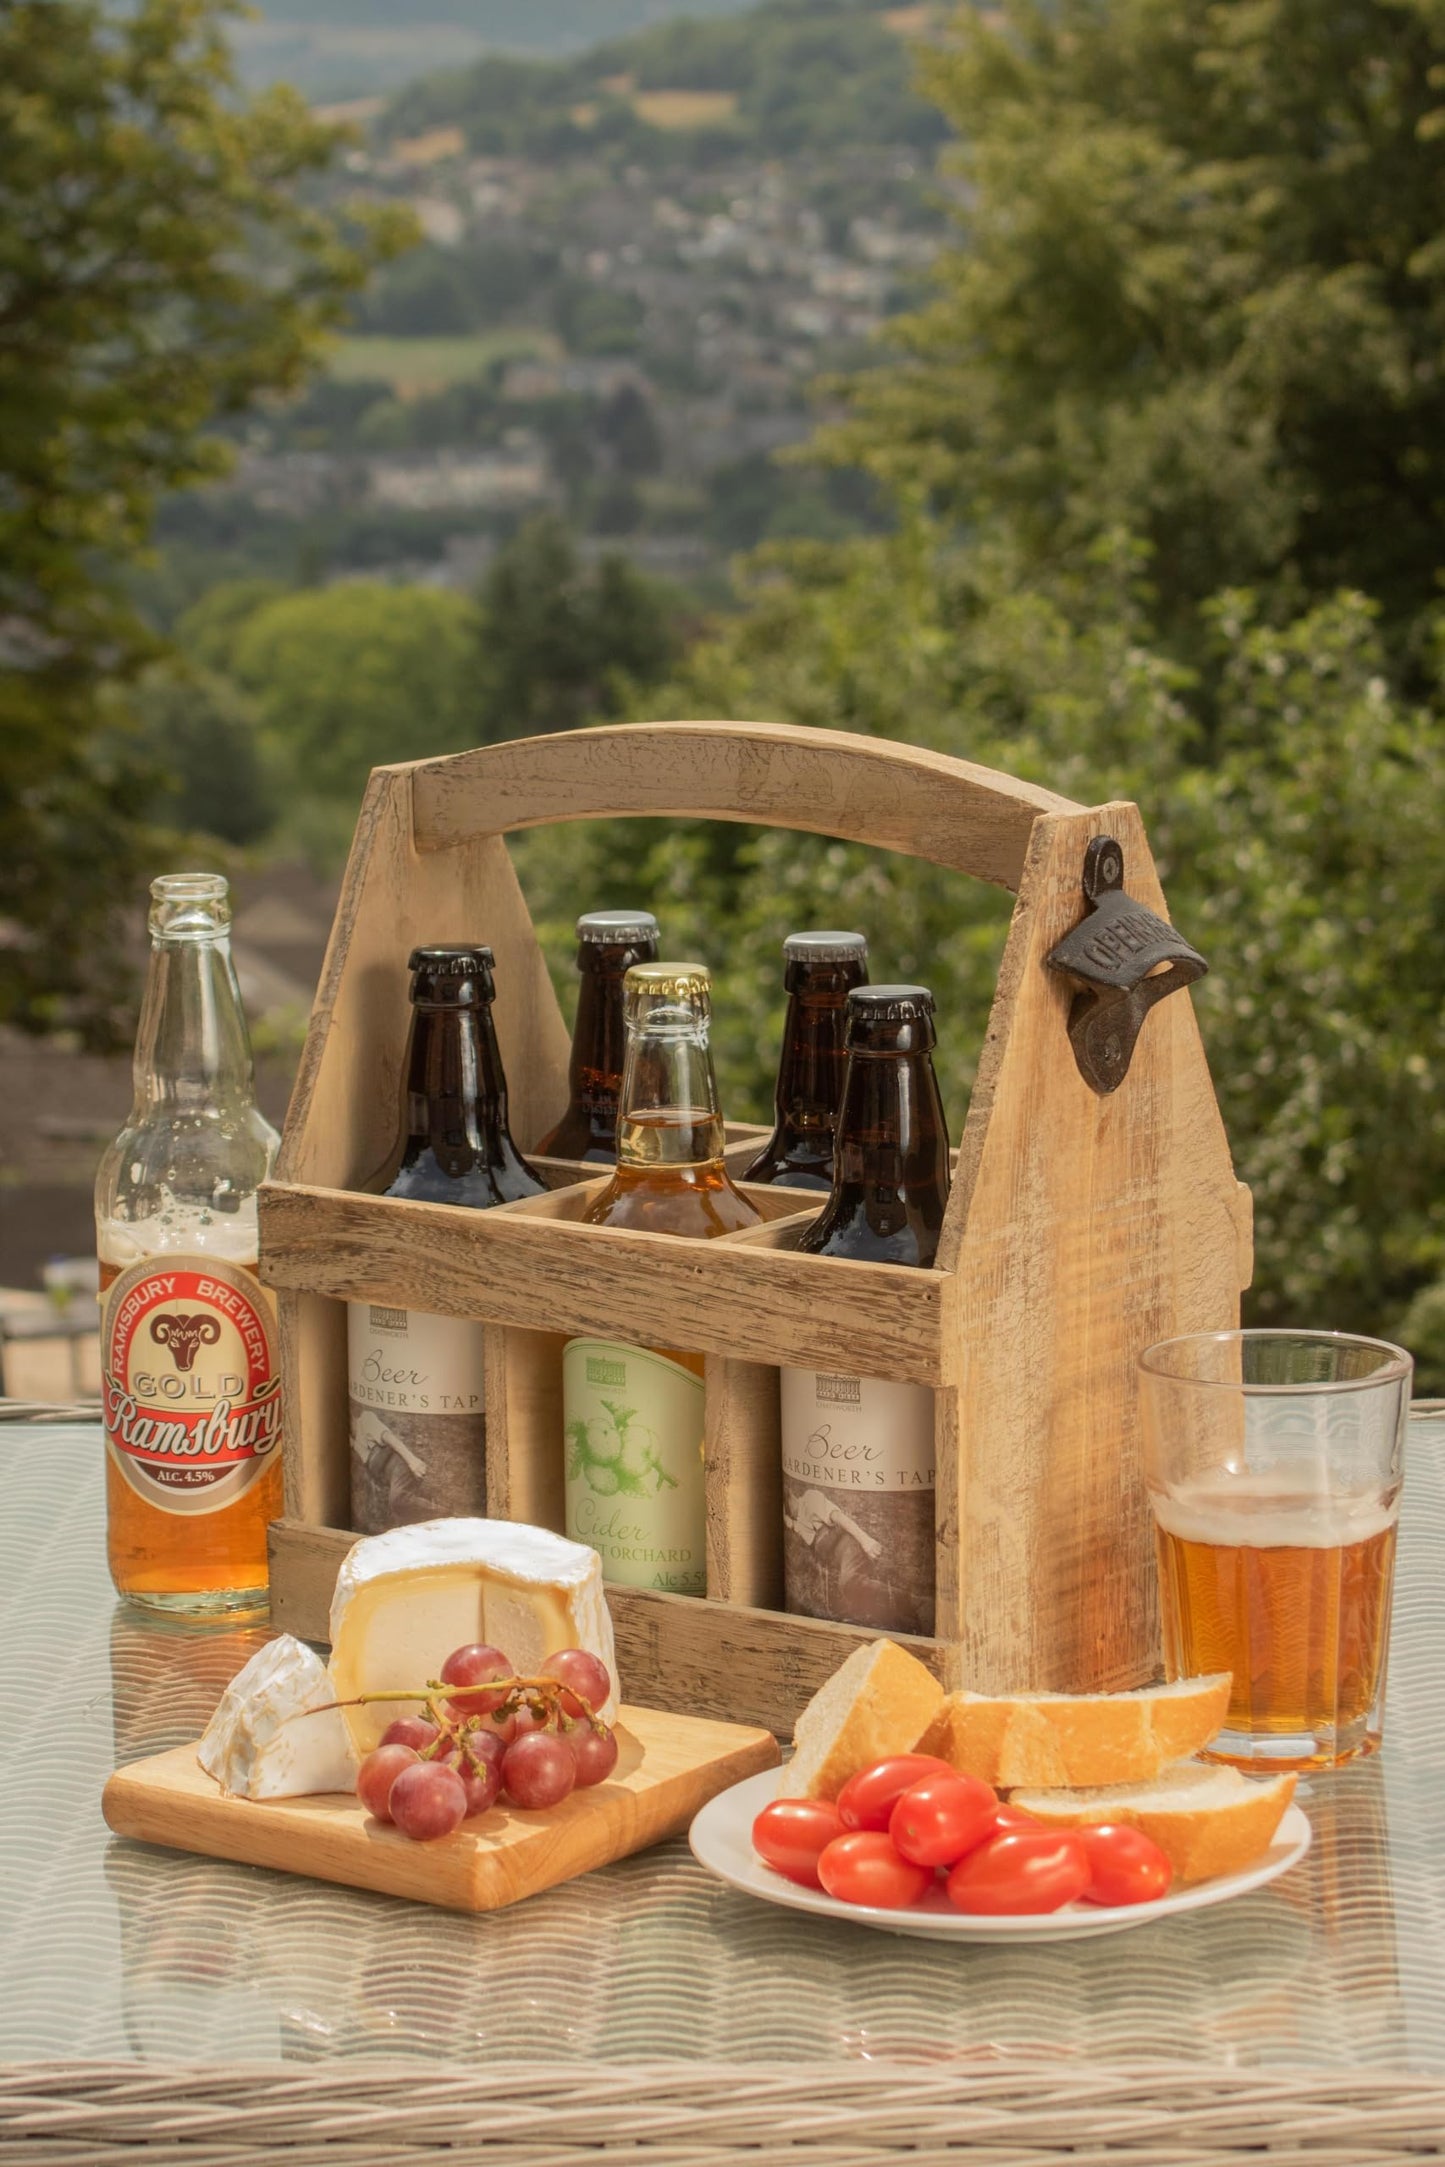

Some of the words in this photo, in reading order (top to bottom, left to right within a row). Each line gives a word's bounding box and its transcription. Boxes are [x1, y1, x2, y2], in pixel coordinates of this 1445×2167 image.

[111, 1277, 177, 1374] RAMSBURY
[196, 1279, 266, 1372] BREWERY
[362, 1349, 429, 1385] Beer
[133, 1371, 244, 1399] GOLD
[440, 1395, 479, 1409] TAP
[104, 1388, 283, 1455] Ramsbury
[805, 1424, 883, 1461] Beer
[184, 1470, 215, 1482] 4.5%
[897, 1469, 936, 1485] TAP
[575, 1498, 650, 1541] Cider
[610, 1546, 692, 1562] ORCHARD
[652, 1571, 677, 1587] Alc
[681, 1571, 705, 1586] 5.5
